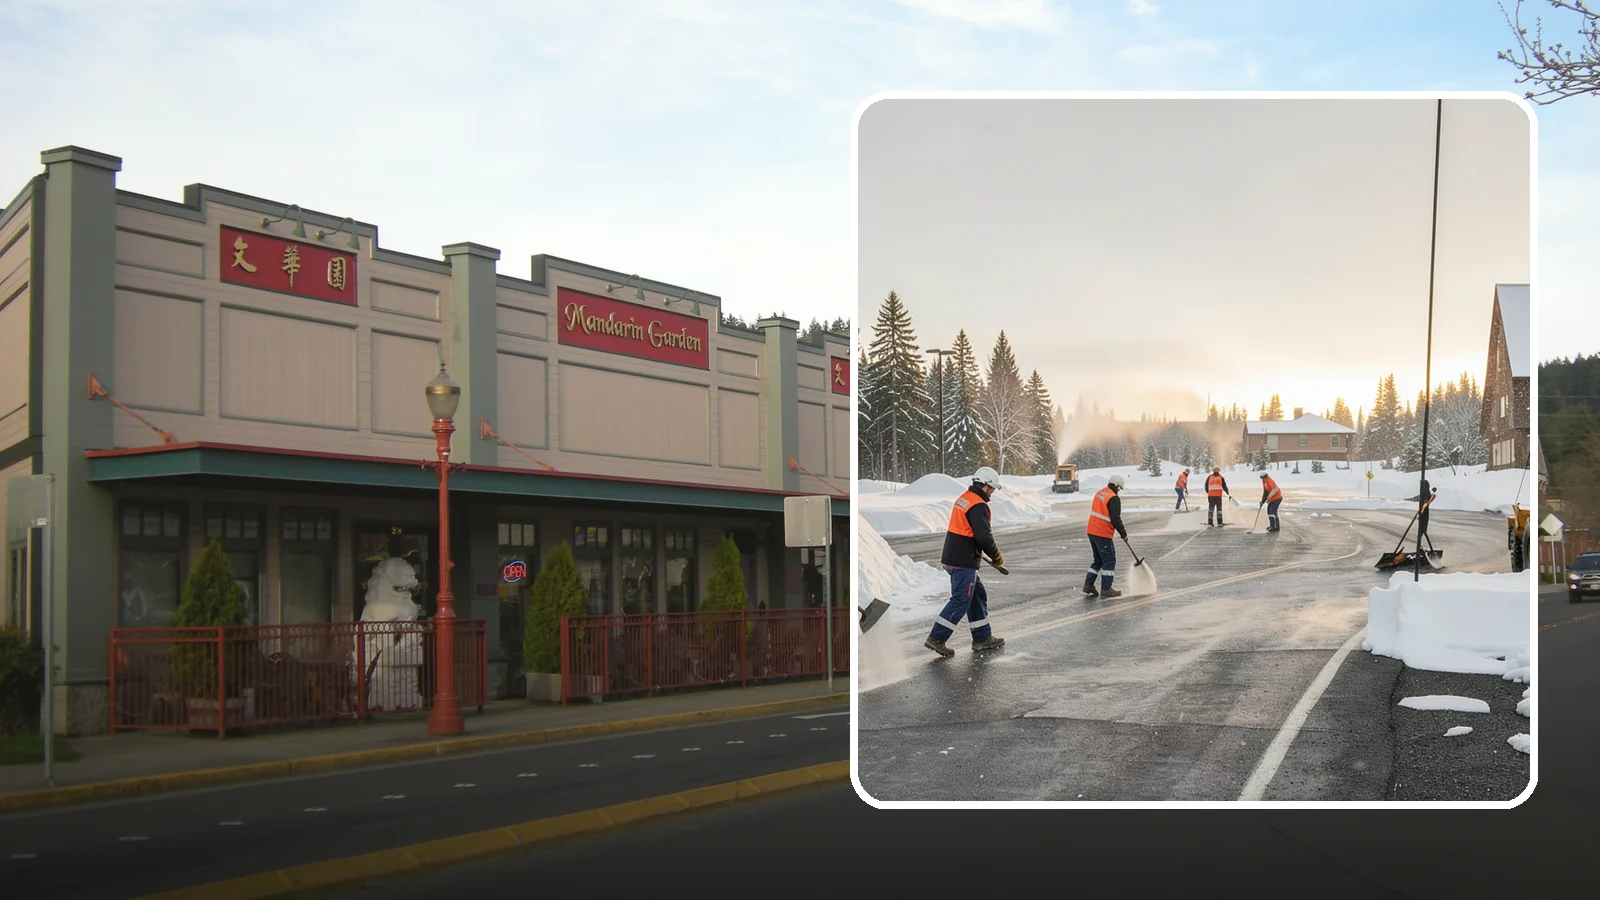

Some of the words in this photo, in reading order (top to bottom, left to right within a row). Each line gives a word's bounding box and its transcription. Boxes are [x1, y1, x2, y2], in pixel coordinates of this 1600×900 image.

[231, 236, 346, 291] 文華園
[564, 302, 644, 341] Mandarin
[647, 320, 701, 352] Garden
[503, 565, 527, 578] OPEN
